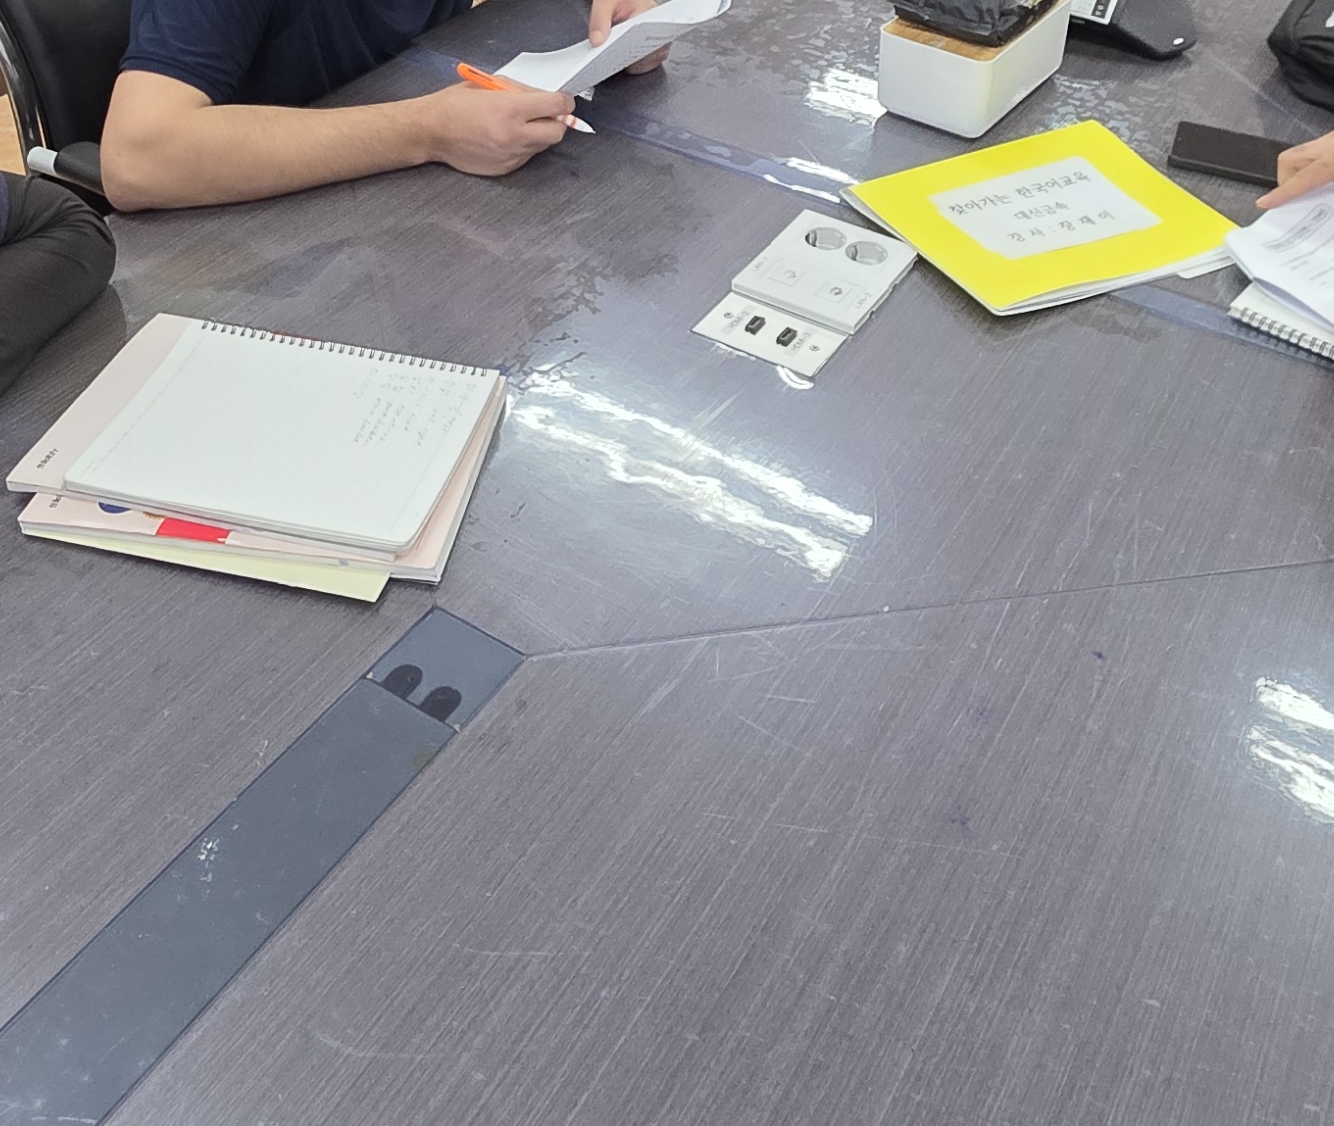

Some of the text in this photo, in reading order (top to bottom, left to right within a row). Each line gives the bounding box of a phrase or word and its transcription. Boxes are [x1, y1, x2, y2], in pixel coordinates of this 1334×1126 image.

[948, 170, 1092, 216] 찾아가는 한국어교육
[1013, 201, 1070, 221] 대신금속
